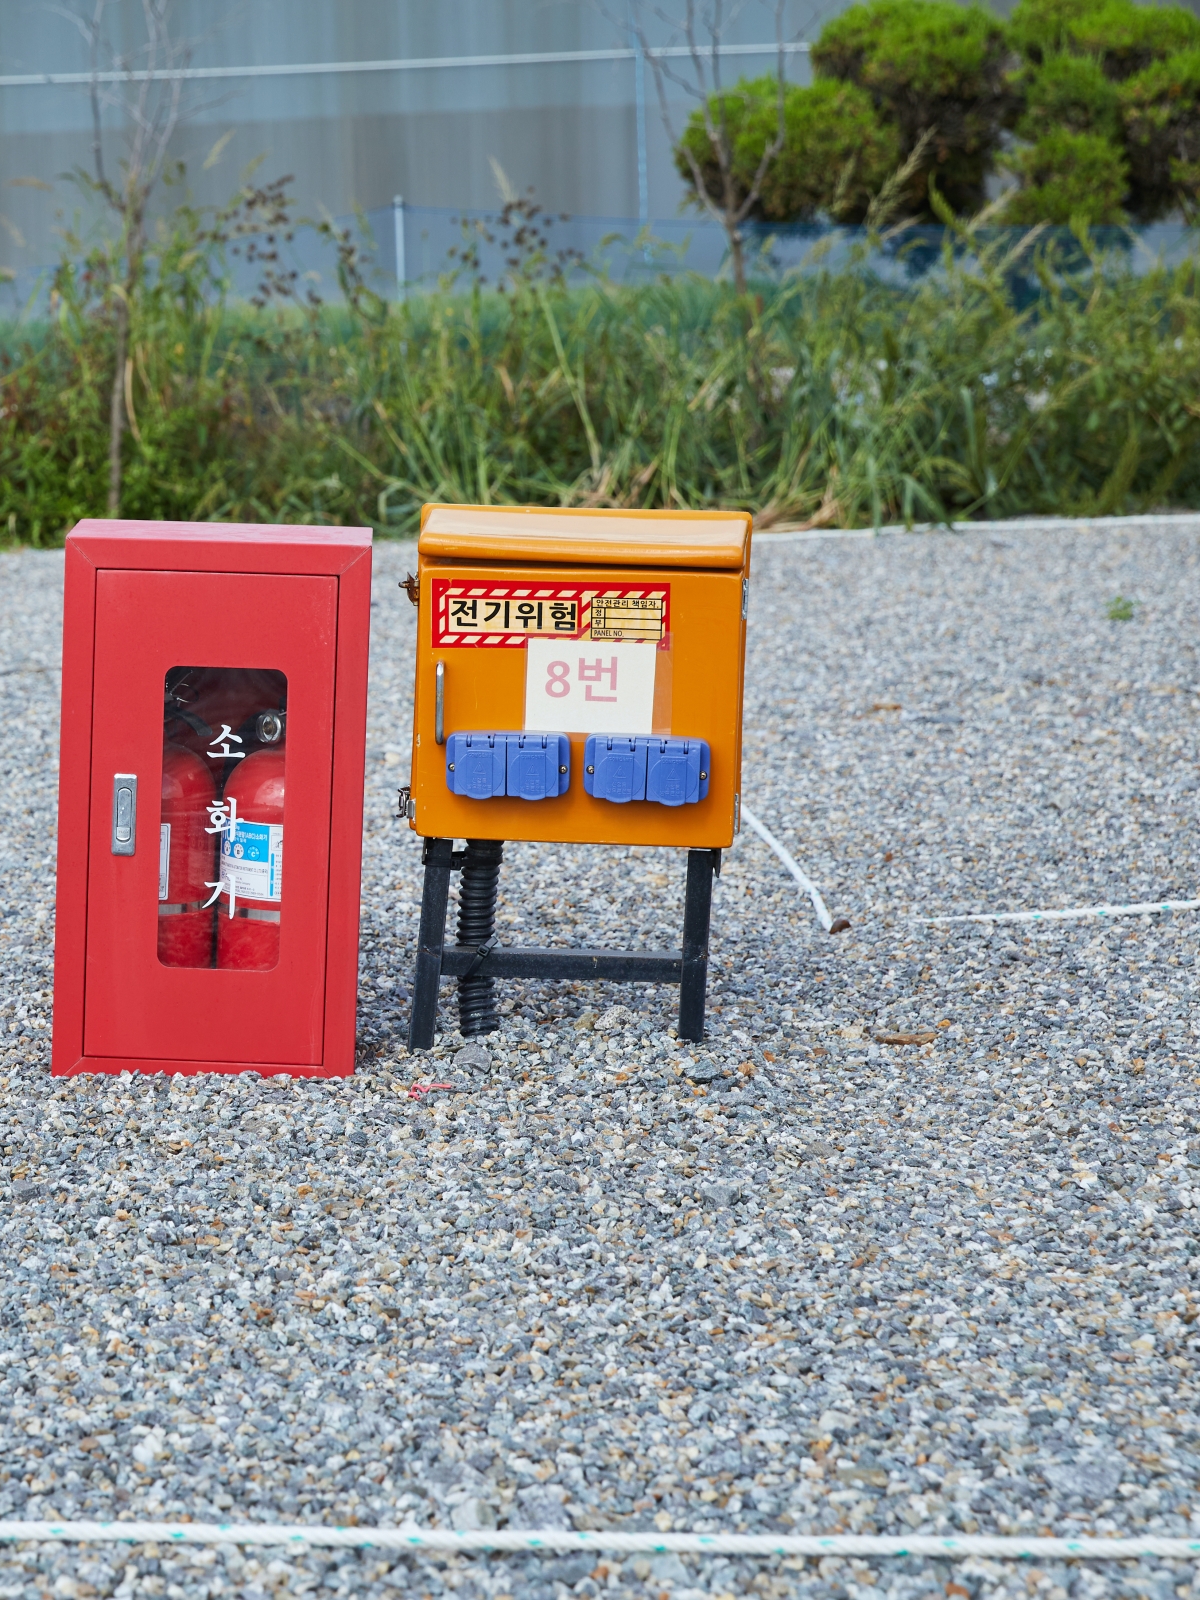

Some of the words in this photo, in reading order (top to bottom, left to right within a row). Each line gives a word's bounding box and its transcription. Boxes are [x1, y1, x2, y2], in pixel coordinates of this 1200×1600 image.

[450, 599, 577, 631] 전기위험
[596, 599, 629, 608] 안전관리
[544, 656, 618, 703] 8번
[202, 724, 246, 920] 소화기
